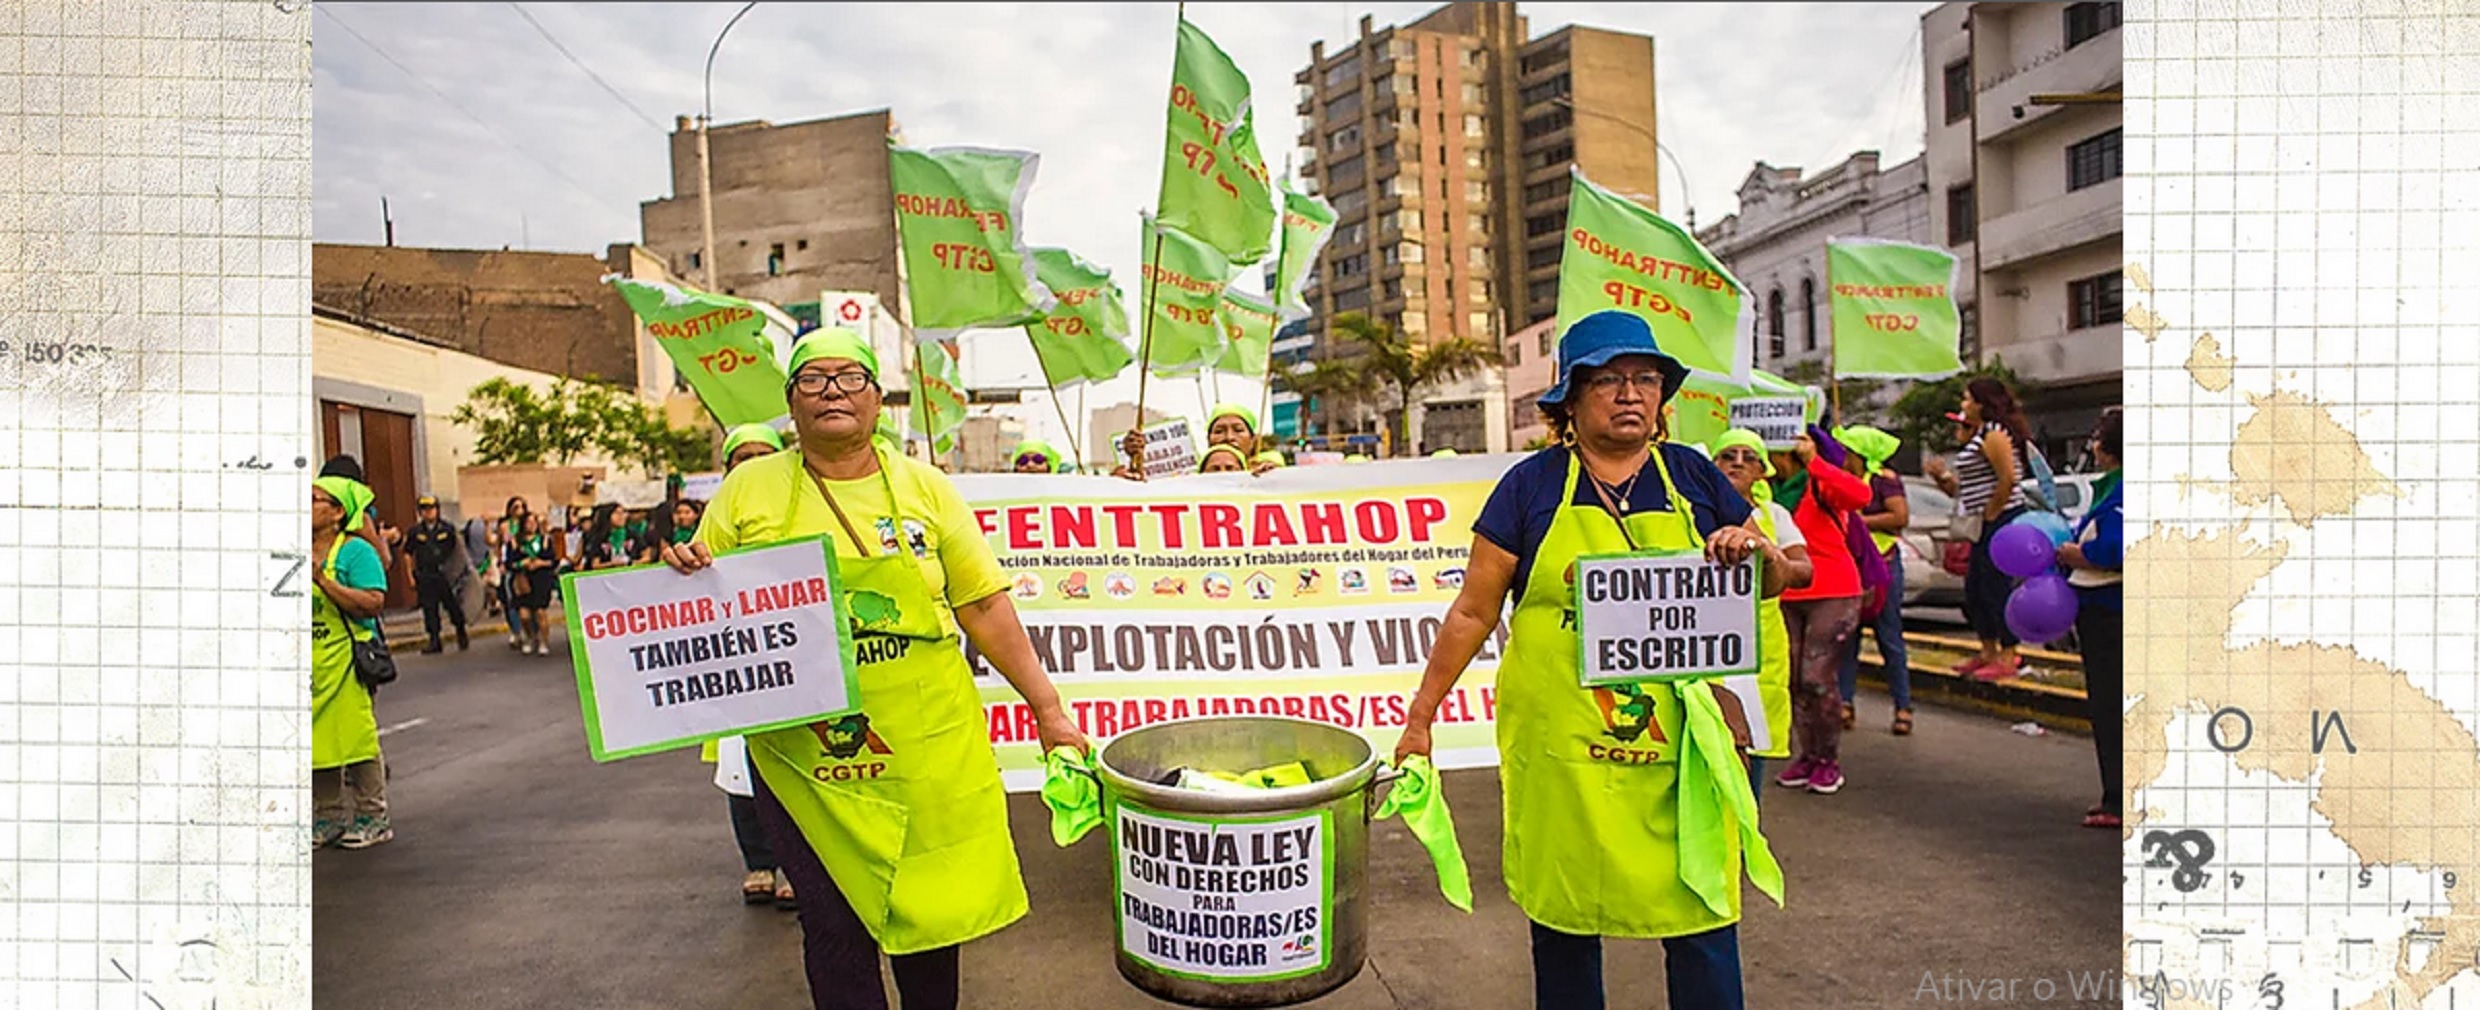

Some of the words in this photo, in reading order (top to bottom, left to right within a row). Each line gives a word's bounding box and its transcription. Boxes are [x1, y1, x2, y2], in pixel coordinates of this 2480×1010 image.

[974, 498, 1446, 550] FENTTRAHOP
[1042, 553, 1109, 567] Nacional
[1111, 552, 1130, 567] de
[1134, 553, 1231, 569] Trabajadoras
[1233, 555, 1242, 568] y
[1244, 551, 1340, 567] Trabajadores
[1342, 549, 1365, 563] del
[1368, 547, 1409, 564] Hogar
[1412, 547, 1434, 560] del
[1585, 563, 1753, 603] CONTRATO
[584, 597, 716, 640] COCINAR
[738, 577, 828, 616] LAVAR
[1649, 605, 1697, 631] POR
[629, 626, 757, 672] TAMBIÉN
[762, 621, 798, 650] ES
[856, 637, 911, 666] AHOP
[1026, 615, 1320, 673] XPLOTACIÓN
[1327, 620, 1356, 667] Y
[1598, 633, 1742, 672] ESCRITO
[646, 661, 795, 707] TRABAJAR
[813, 762, 886, 782] CGTP
[1589, 745, 1660, 765] CGTP
[1122, 816, 1240, 866] NUEVA
[1252, 825, 1316, 866] LEY
[1129, 854, 1170, 887] CON
[1176, 863, 1309, 893] DERECHOS
[1122, 892, 1318, 939] TRABAJADORAS/ES
[1193, 894, 1236, 911] PARA
[1147, 931, 1181, 960] DEL
[1185, 942, 1267, 966] HOGAR
